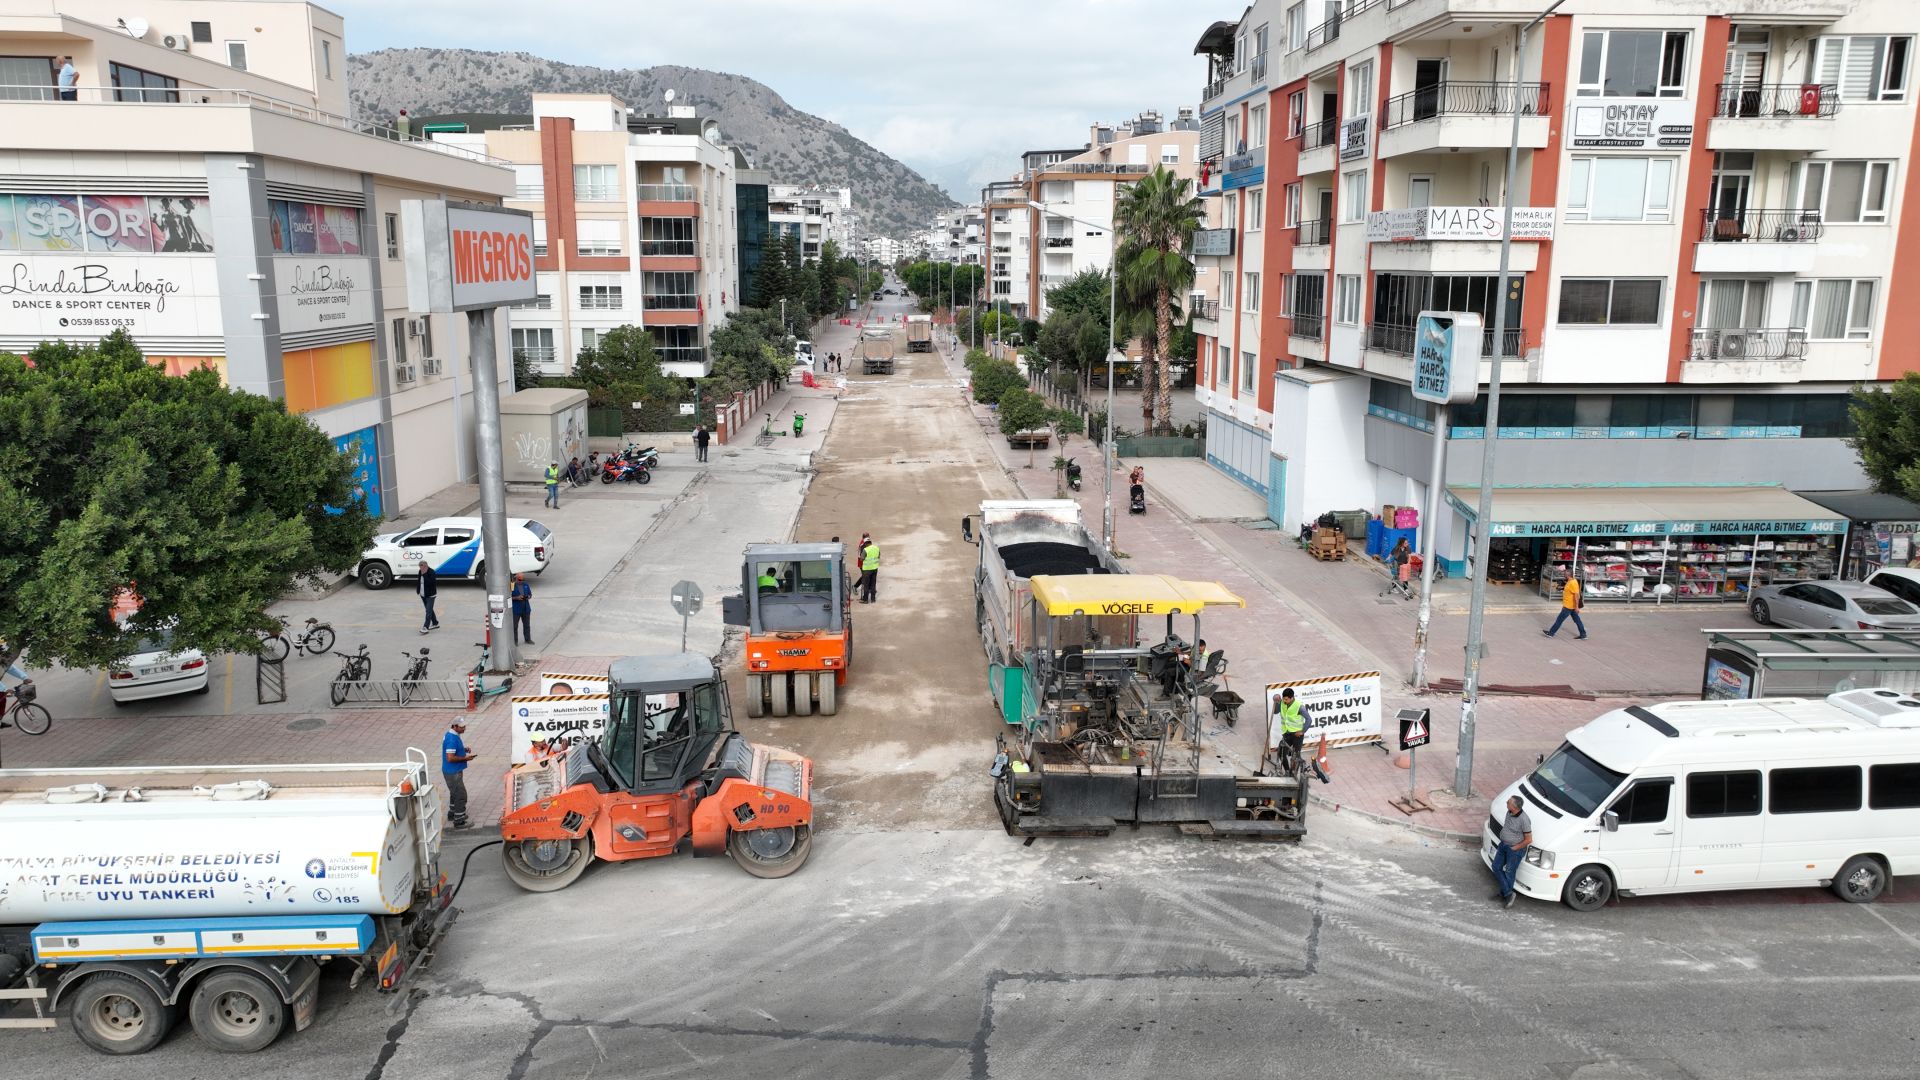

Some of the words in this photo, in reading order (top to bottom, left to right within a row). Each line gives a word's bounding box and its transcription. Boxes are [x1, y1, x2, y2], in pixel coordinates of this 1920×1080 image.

[1606, 105, 1658, 121] OKTAY
[1431, 208, 1497, 230] MARS
[1514, 210, 1553, 219] MİMARLIK
[25, 206, 146, 238] SPOR
[1511, 221, 1530, 229] ERIOR
[12, 300, 52, 309] DANCE
[56, 300, 63, 309] &
[66, 301, 103, 309] SPORT
[107, 301, 151, 310] CENTER
[70, 318, 93, 326] 0539
[95, 318, 110, 326] 853
[1420, 361, 1446, 378] HARCA
[1531, 524, 1562, 534] HARCA
[1563, 524, 1594, 534] HARCA
[1709, 522, 1740, 532] HARCA
[1741, 522, 1772, 532] HARCA
[1101, 601, 1154, 614] VÖGELE
[1305, 700, 1333, 712] MUR
[1336, 696, 1371, 709] SUYU
[524, 718, 589, 732] YAĞMUR
[1407, 737, 1426, 747] YAVAŞ
[760, 803, 775, 814] HD
[777, 803, 790, 814] 90
[519, 815, 548, 825] HAMM
[180, 850, 281, 866] BELEDİYESİ
[129, 869, 239, 885] MÜDÜRLÜĞÜ
[138, 886, 216, 901] TANKERİ
[335, 895, 361, 904] 185
